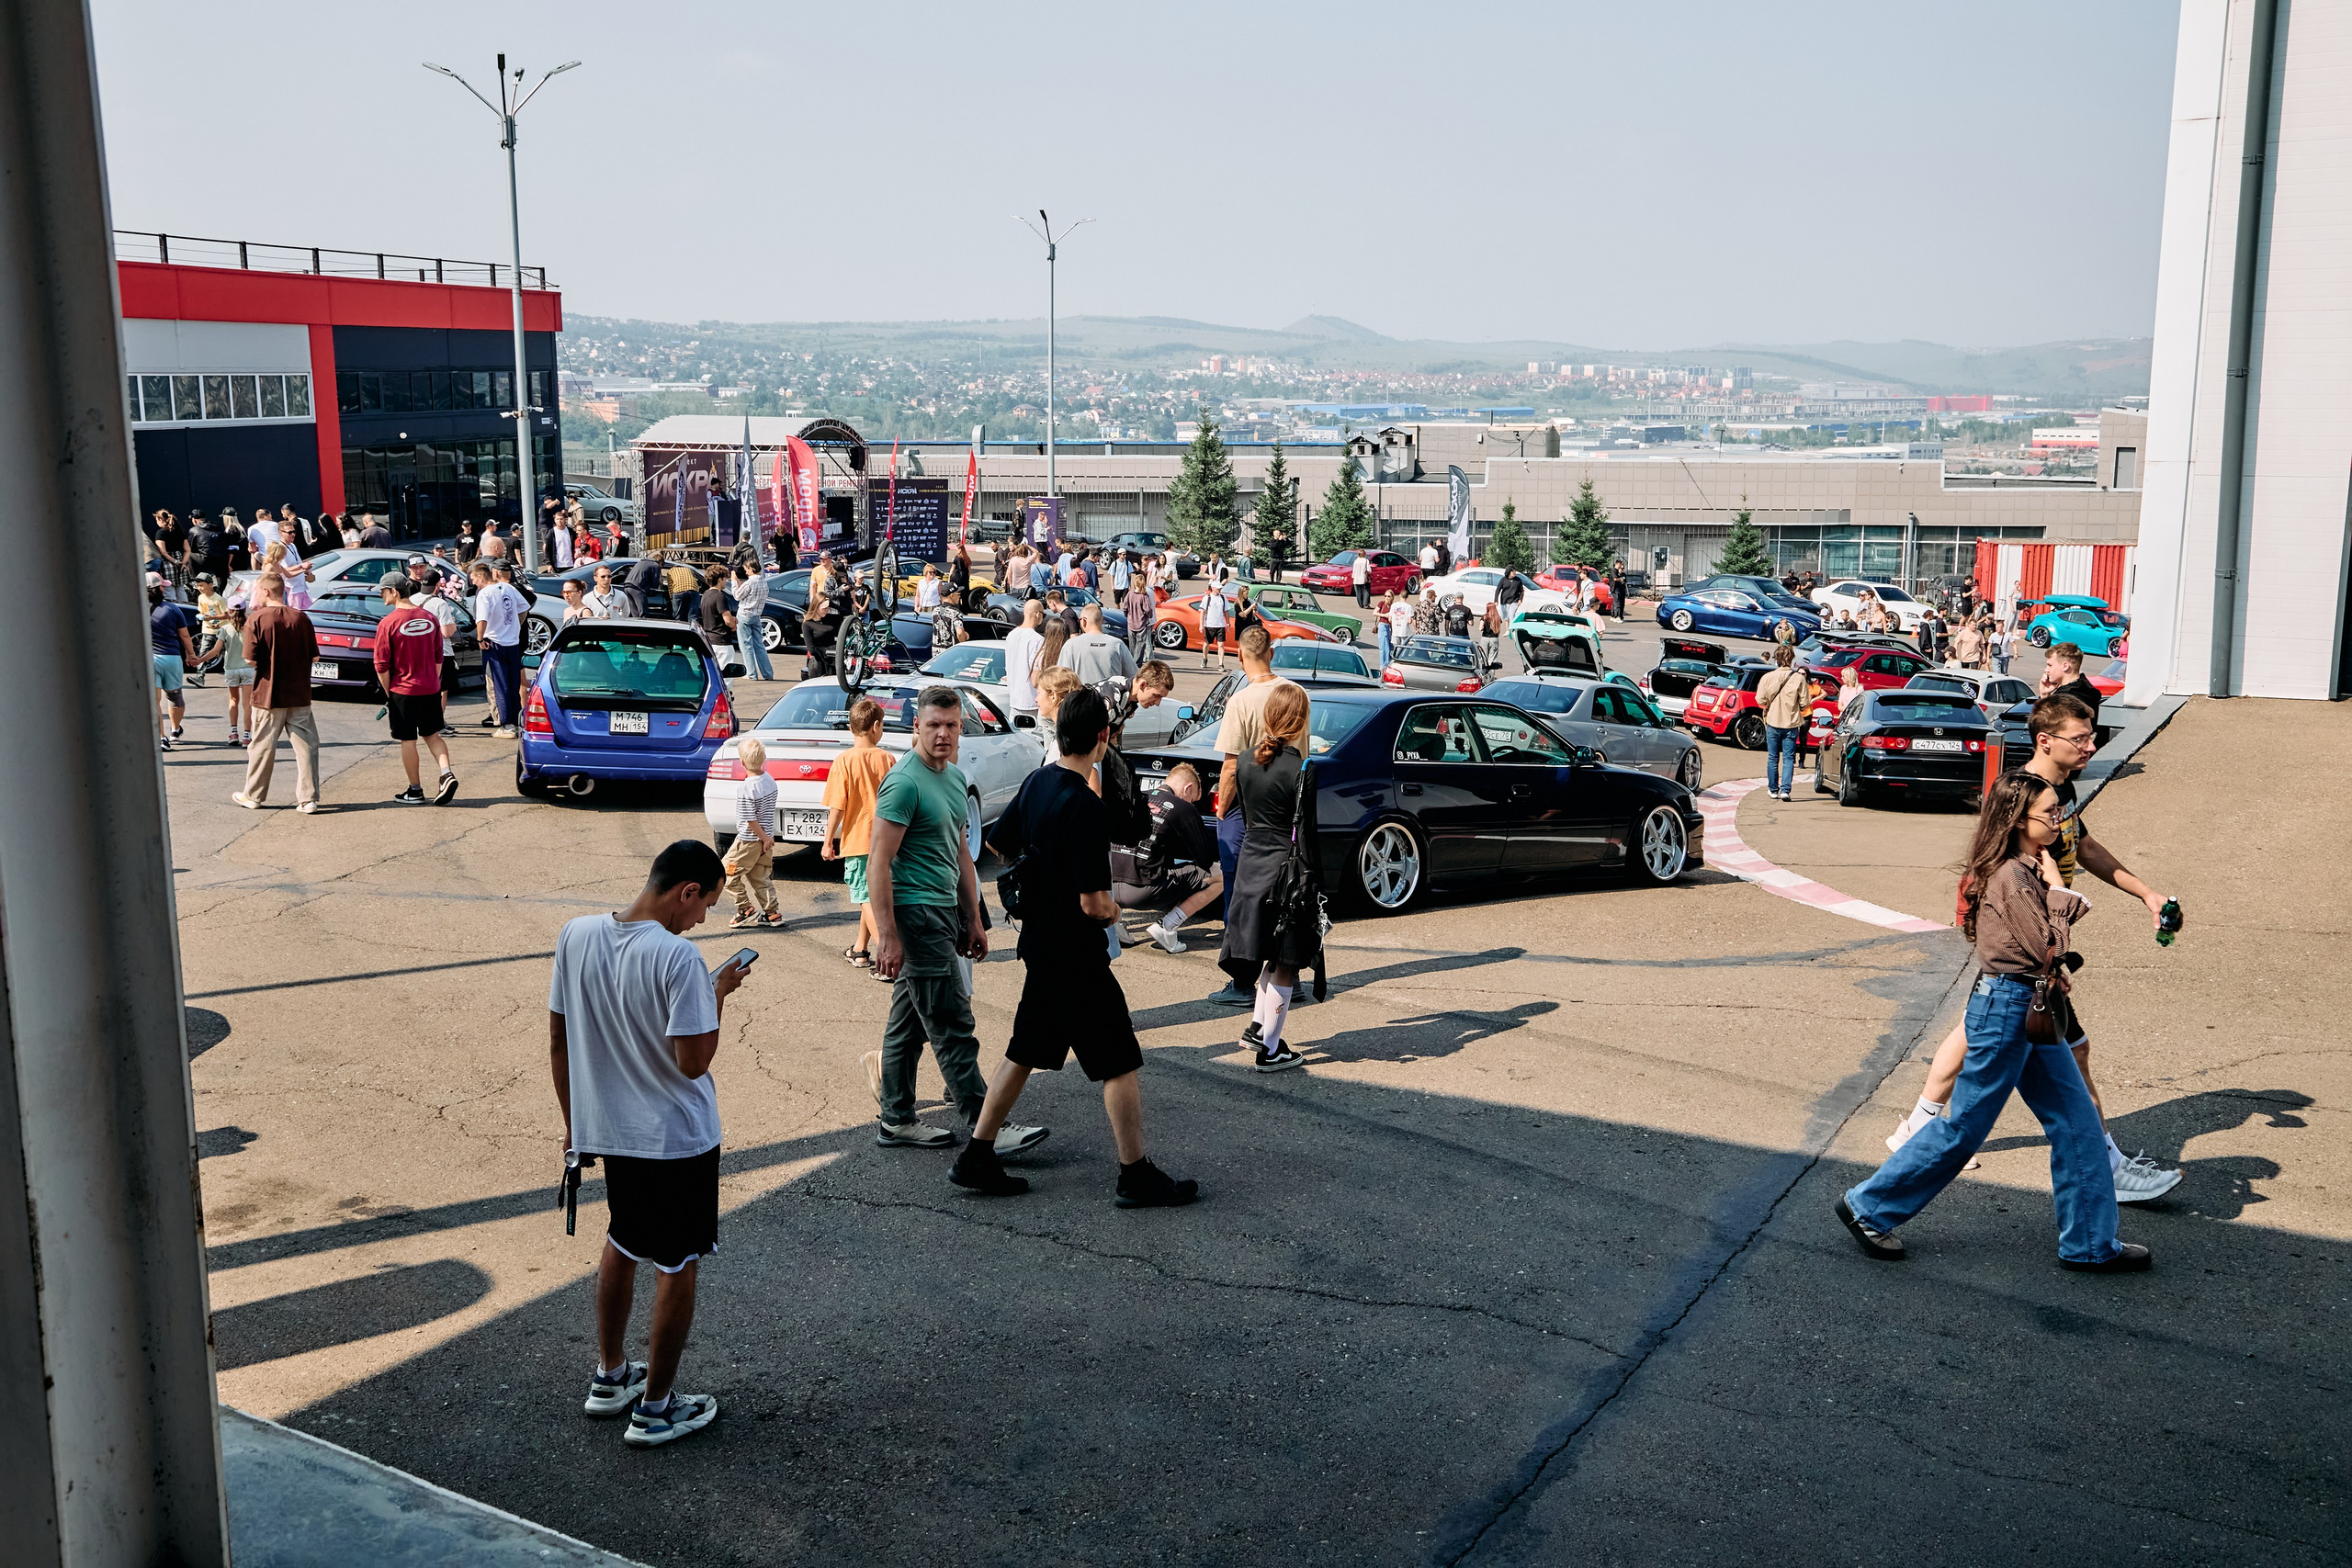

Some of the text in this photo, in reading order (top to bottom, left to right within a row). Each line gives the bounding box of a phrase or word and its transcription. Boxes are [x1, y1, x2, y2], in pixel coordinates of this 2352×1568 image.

[627, 713, 643, 721] 746
[614, 723, 628, 731] МН
[790, 812, 822, 824] Т 282
[786, 824, 825, 836] ЕХ 124
